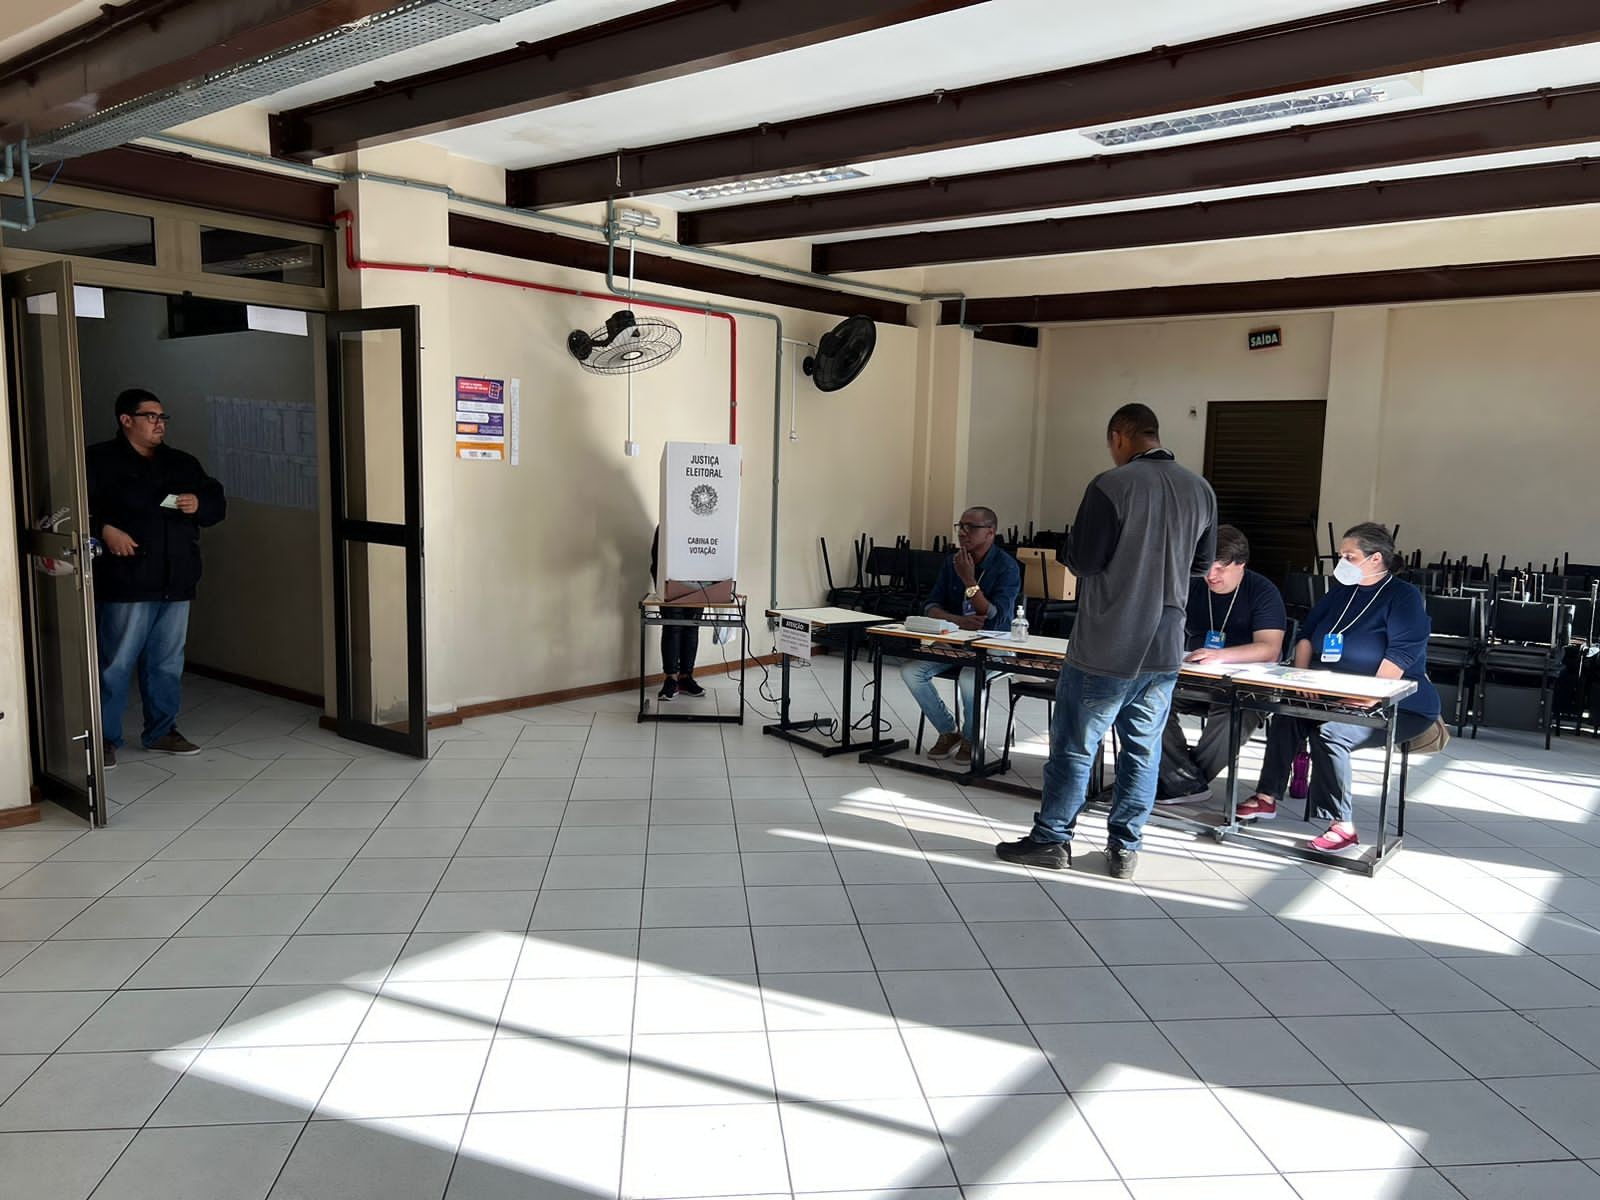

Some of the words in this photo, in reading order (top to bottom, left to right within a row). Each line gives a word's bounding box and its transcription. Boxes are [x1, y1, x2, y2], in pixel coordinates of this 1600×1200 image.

[690, 455, 720, 467] JUSTIÇA
[685, 467, 723, 479] ELEITORAL
[687, 537, 709, 545] CABINA
[710, 538, 719, 546] DE
[689, 546, 717, 556] VOTAÇÃO
